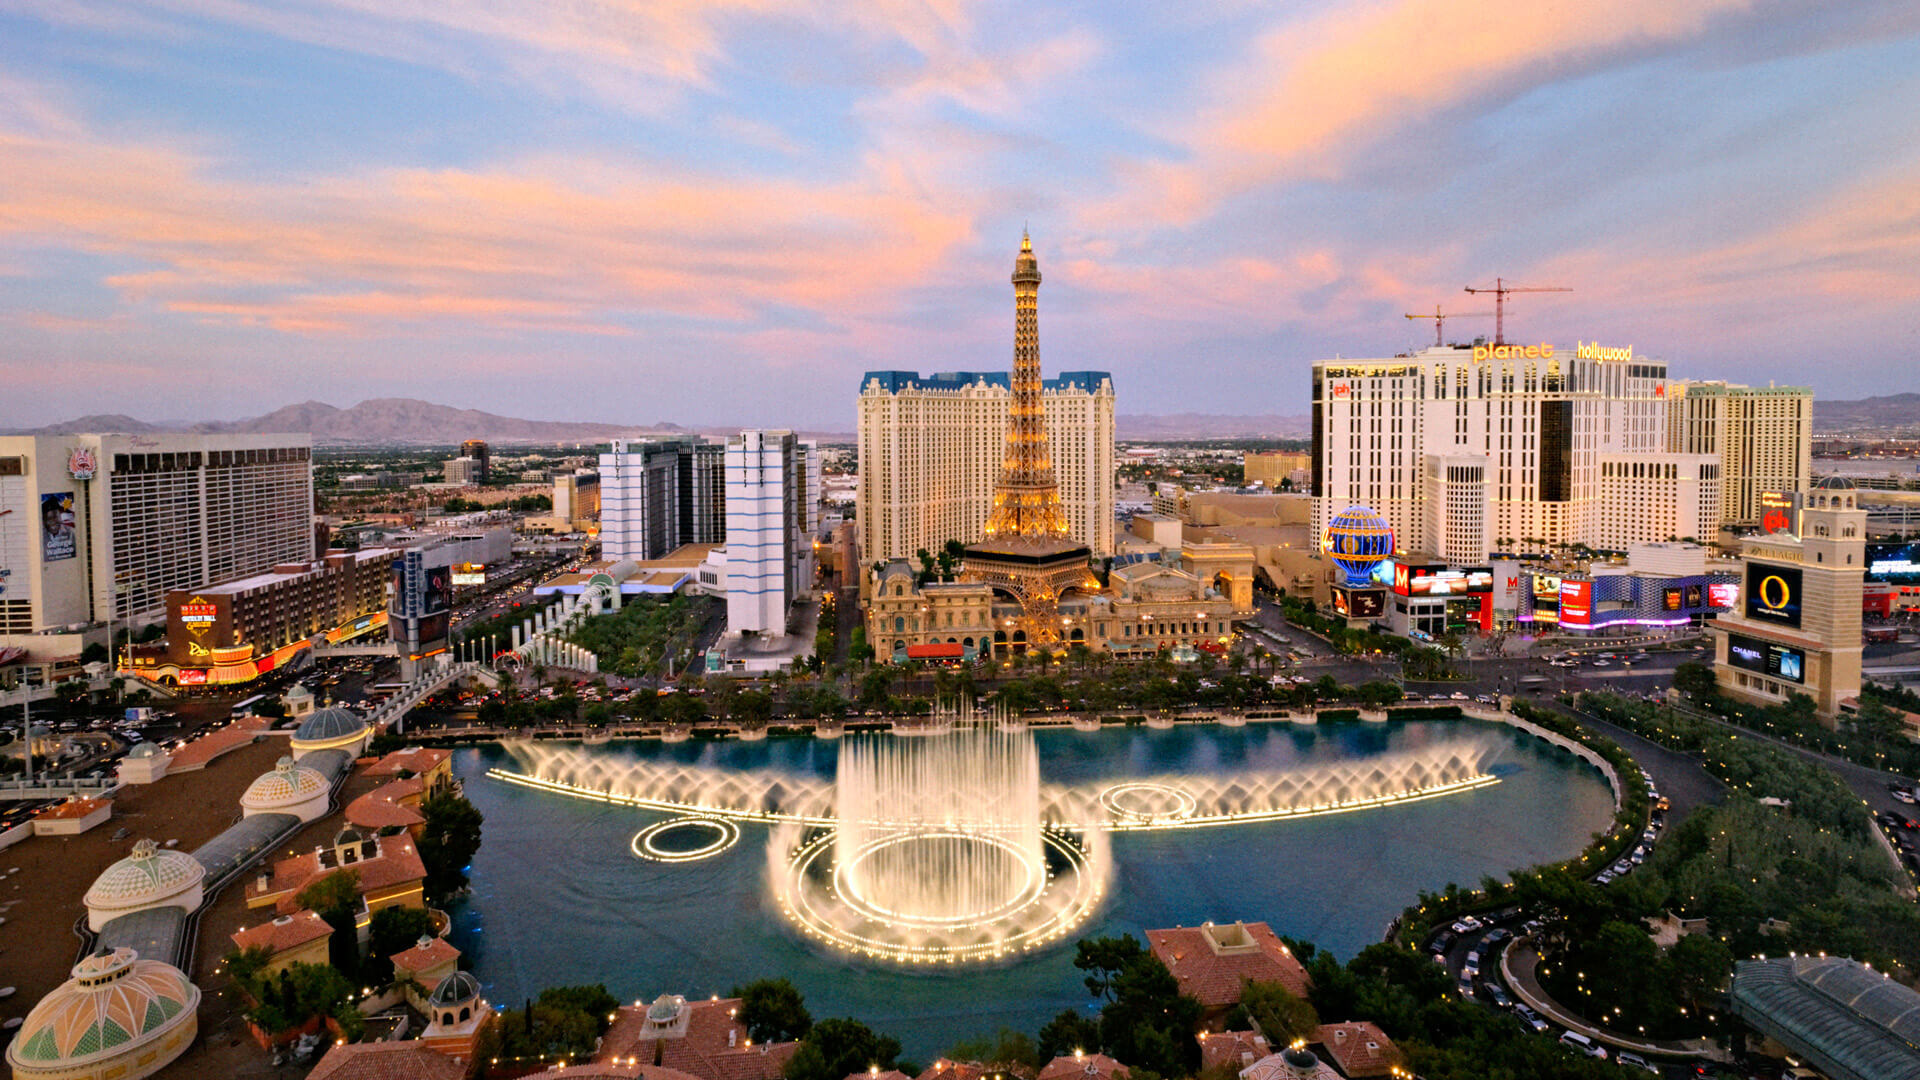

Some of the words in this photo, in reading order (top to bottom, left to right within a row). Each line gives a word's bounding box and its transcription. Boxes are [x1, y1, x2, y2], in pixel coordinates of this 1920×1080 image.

[1473, 341, 1554, 364] planet
[1577, 340, 1632, 364] hollywood
[1765, 510, 1789, 532] ph
[1396, 566, 1408, 589] M
[1507, 576, 1518, 587] M
[1759, 575, 1790, 608] O
[1732, 646, 1762, 659] CHANEL
